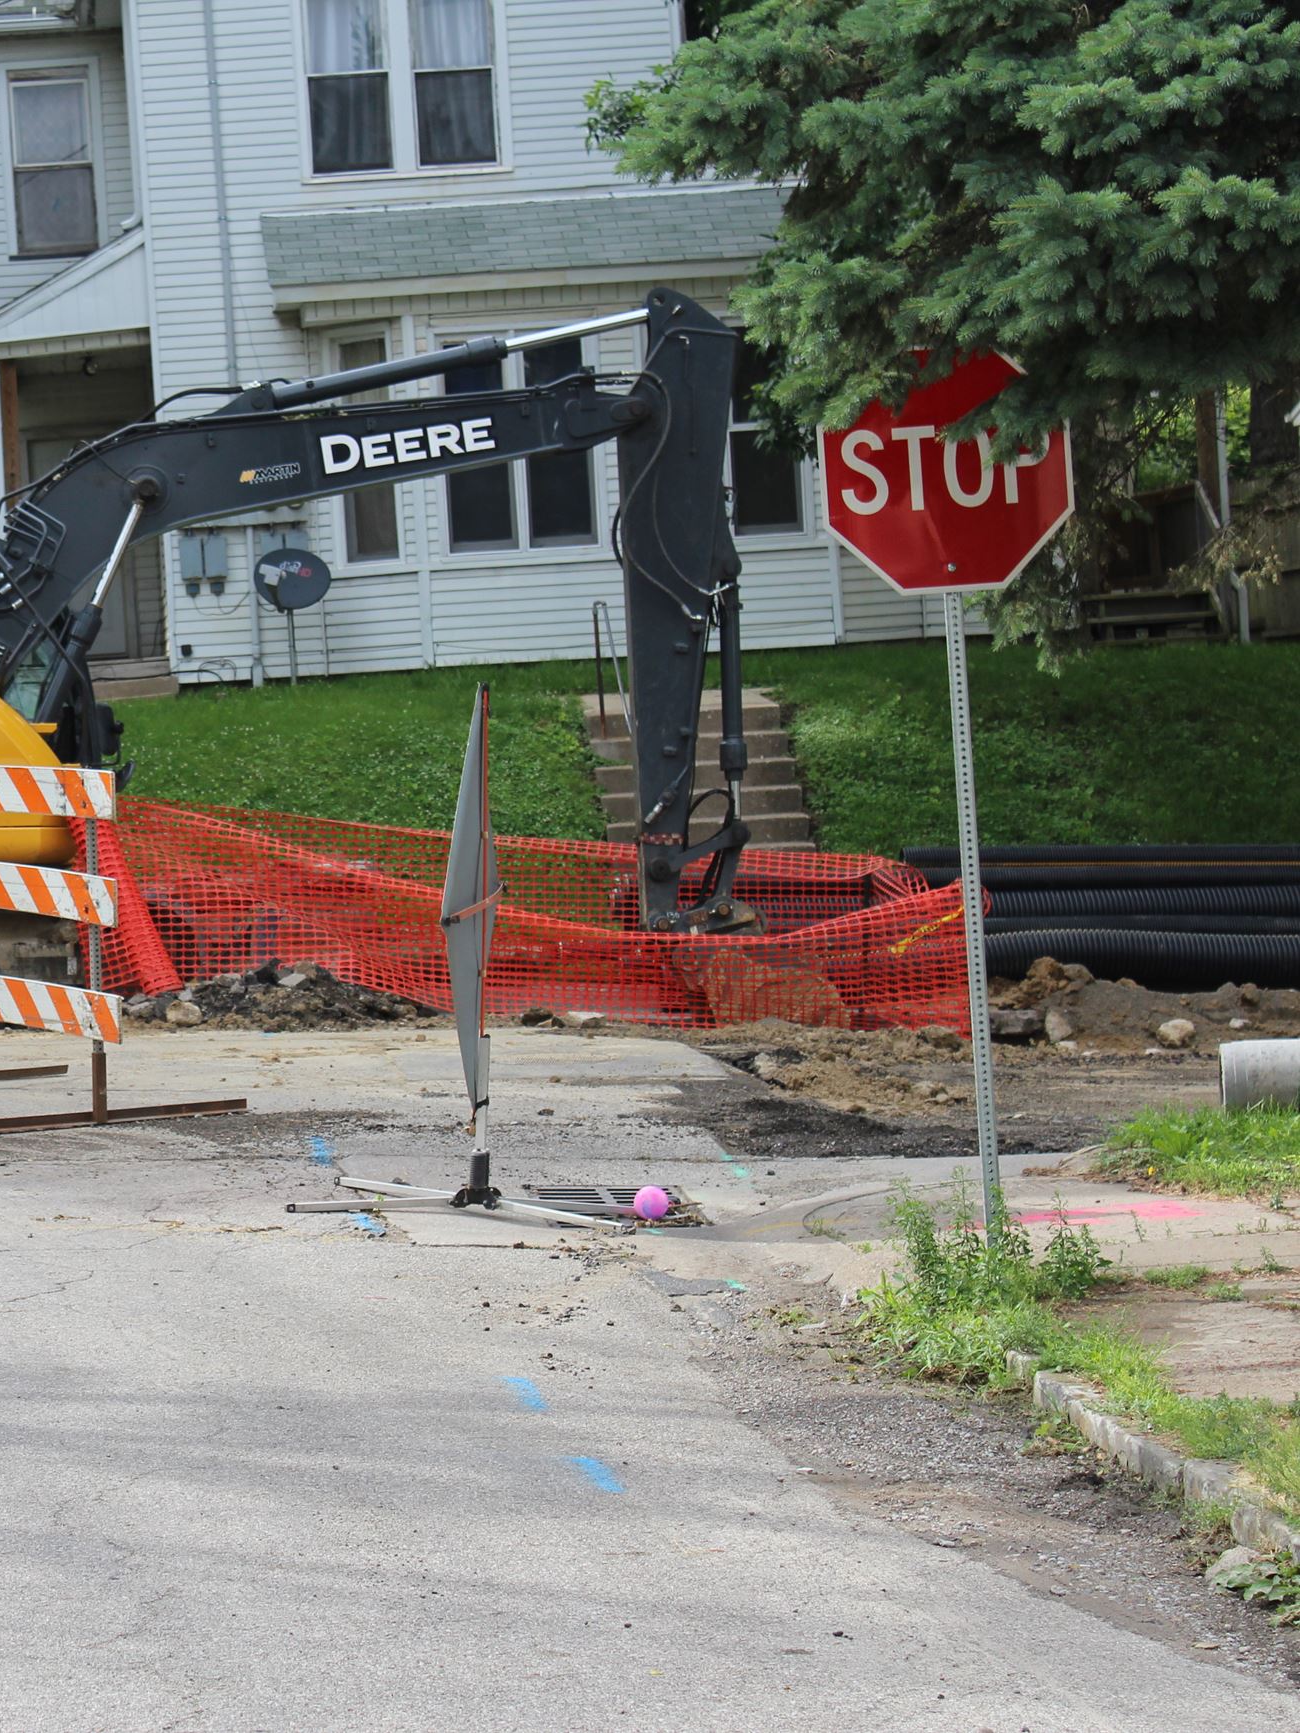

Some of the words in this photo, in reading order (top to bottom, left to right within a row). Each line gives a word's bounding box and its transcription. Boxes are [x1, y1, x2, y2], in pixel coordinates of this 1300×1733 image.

[253, 462, 301, 480] MARTIN
[320, 417, 496, 475] DEERE
[840, 425, 1050, 516] STOP
